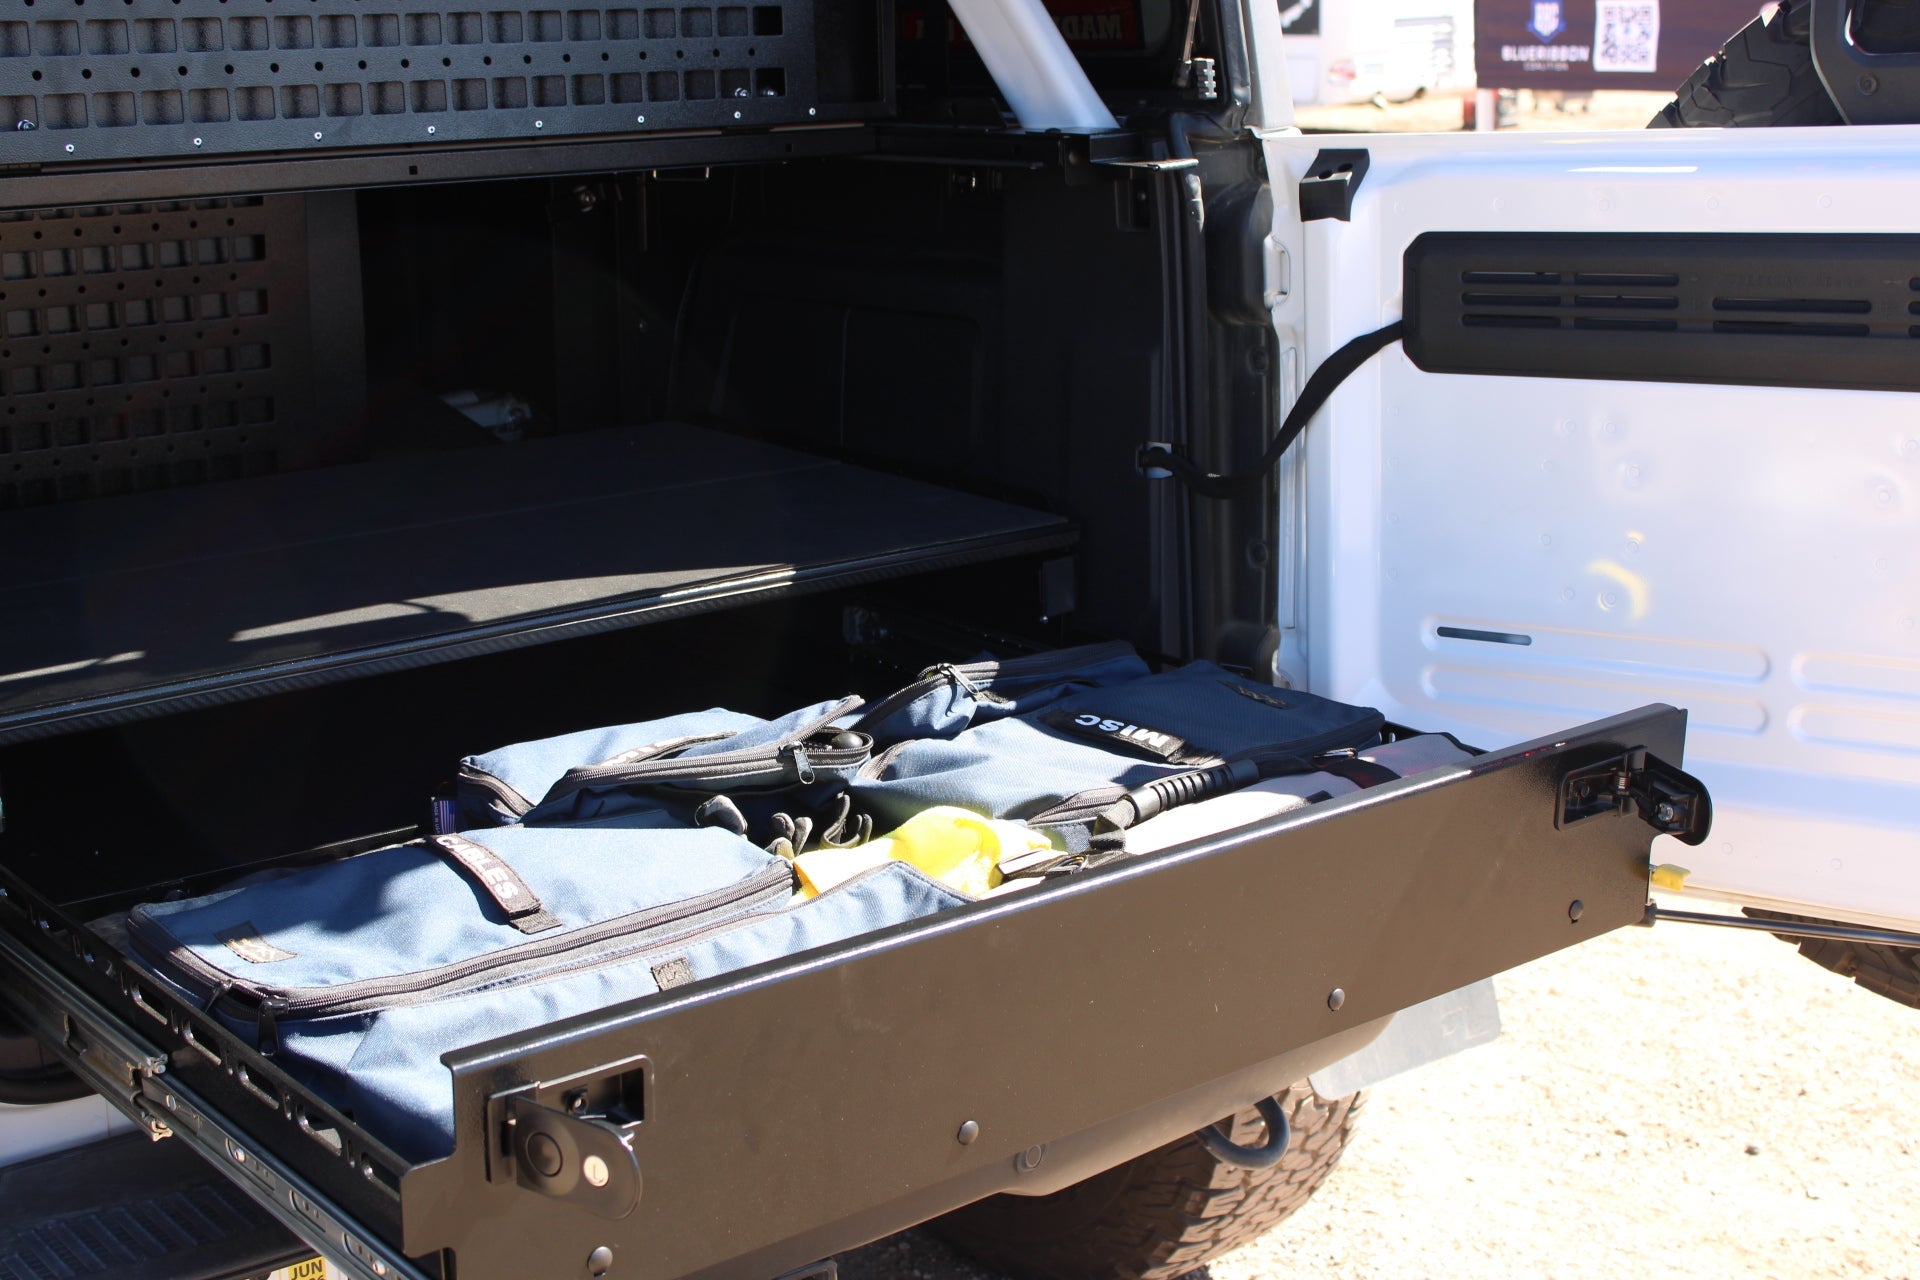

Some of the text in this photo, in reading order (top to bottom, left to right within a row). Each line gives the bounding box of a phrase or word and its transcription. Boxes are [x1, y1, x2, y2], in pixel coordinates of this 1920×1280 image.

[1074, 714, 1170, 748] MISC
[436, 836, 519, 899] CABLES
[291, 1259, 323, 1280] JUN
